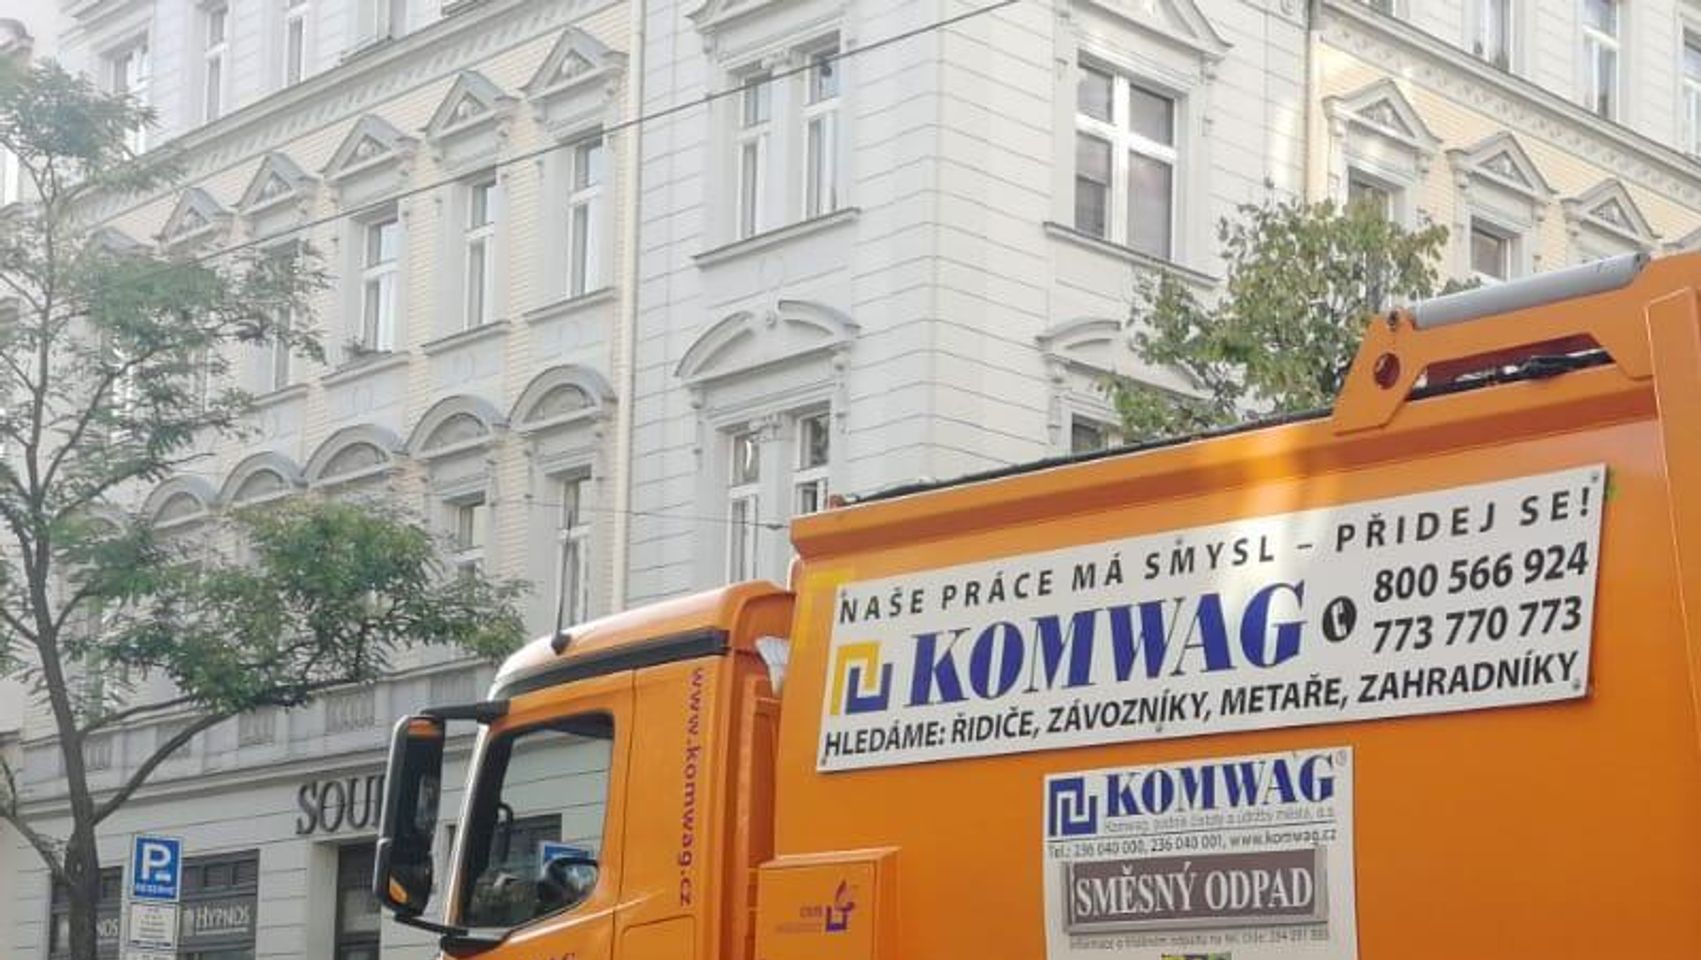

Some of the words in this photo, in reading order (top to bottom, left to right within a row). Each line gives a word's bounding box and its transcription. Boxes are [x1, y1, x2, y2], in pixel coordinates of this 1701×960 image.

[839, 586, 925, 625] NAŠE
[941, 569, 1054, 611] PRÁCE
[1071, 552, 1123, 592] MÁ
[1144, 535, 1274, 580] SMYSL
[1335, 502, 1496, 552] PŘIDEJ
[1520, 486, 1590, 526] SE!
[1373, 563, 1439, 603] 800
[1448, 552, 1513, 594] 566
[1524, 541, 1588, 584] 924
[903, 579, 1308, 709] KOMWAG
[1373, 614, 1433, 654] 773
[1446, 605, 1509, 647] 770
[1519, 595, 1583, 637] 773
[824, 718, 946, 757] HLEDÁME:
[951, 706, 1039, 744] ŘIDIČE,
[1047, 687, 1211, 733] ZÁVOZNÍKY,
[1220, 672, 1348, 716] METAŘE,
[1358, 650, 1579, 703] ZAHRADNÍKY
[677, 667, 704, 907] www.komwag.cz
[1105, 754, 1336, 819] KOMWAG
[1075, 861, 1198, 917] SMĚSNÝ
[1205, 867, 1314, 911] ODPAD
